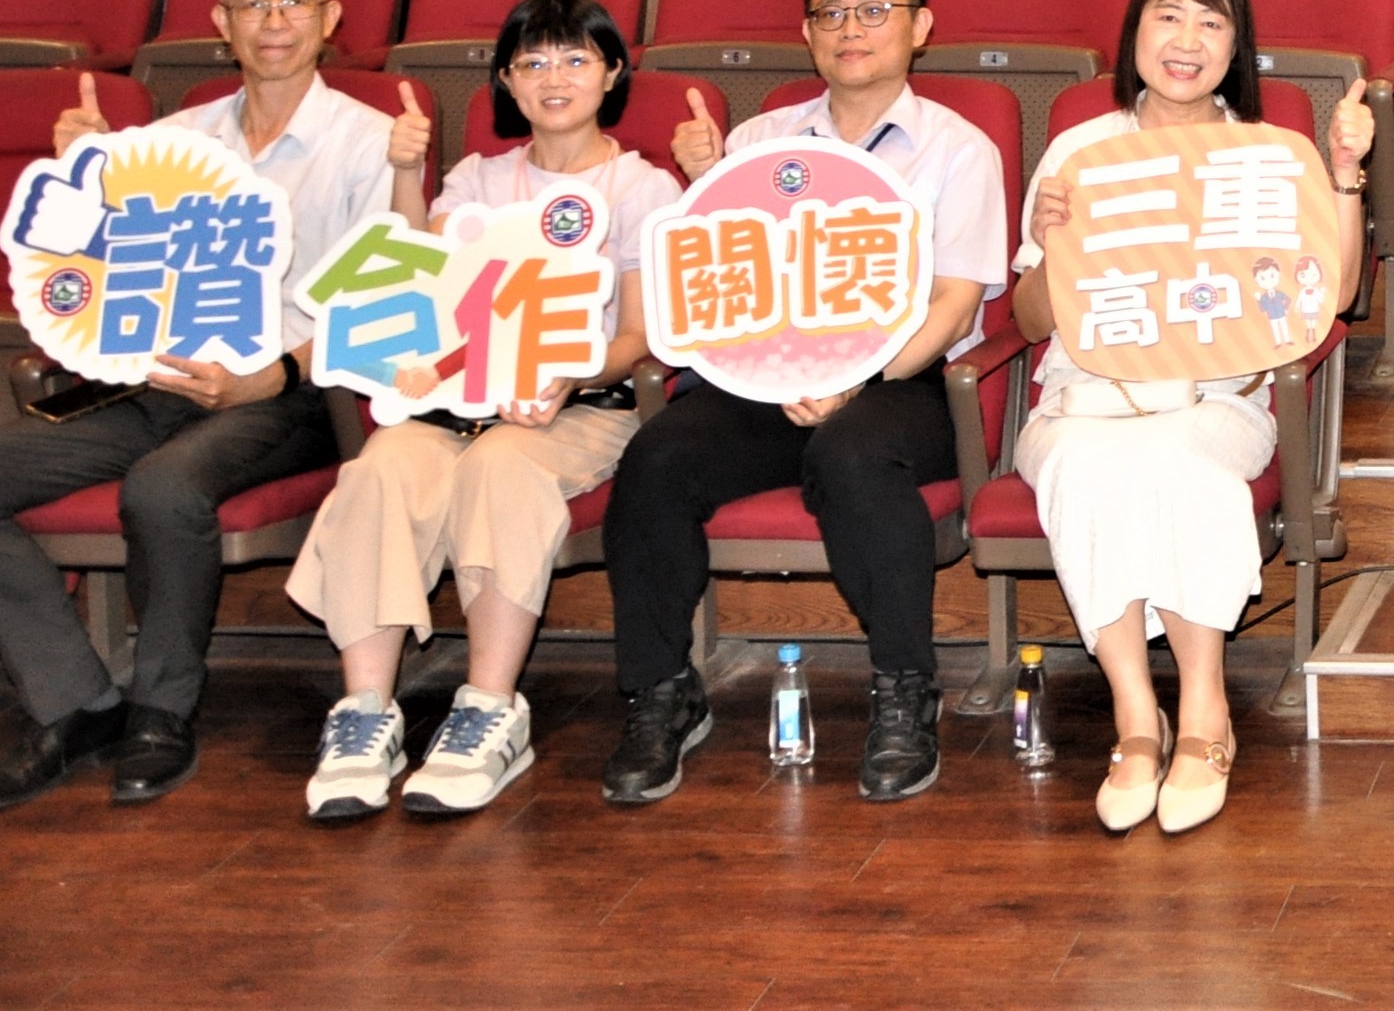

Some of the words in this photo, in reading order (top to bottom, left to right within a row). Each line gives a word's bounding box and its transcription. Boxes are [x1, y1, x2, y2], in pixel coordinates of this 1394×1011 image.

[1077, 144, 1306, 254] 三重
[100, 193, 276, 358] 讚
[306, 223, 601, 403] 合作
[666, 207, 903, 336] 關懷
[1076, 263, 1243, 351] 高中
